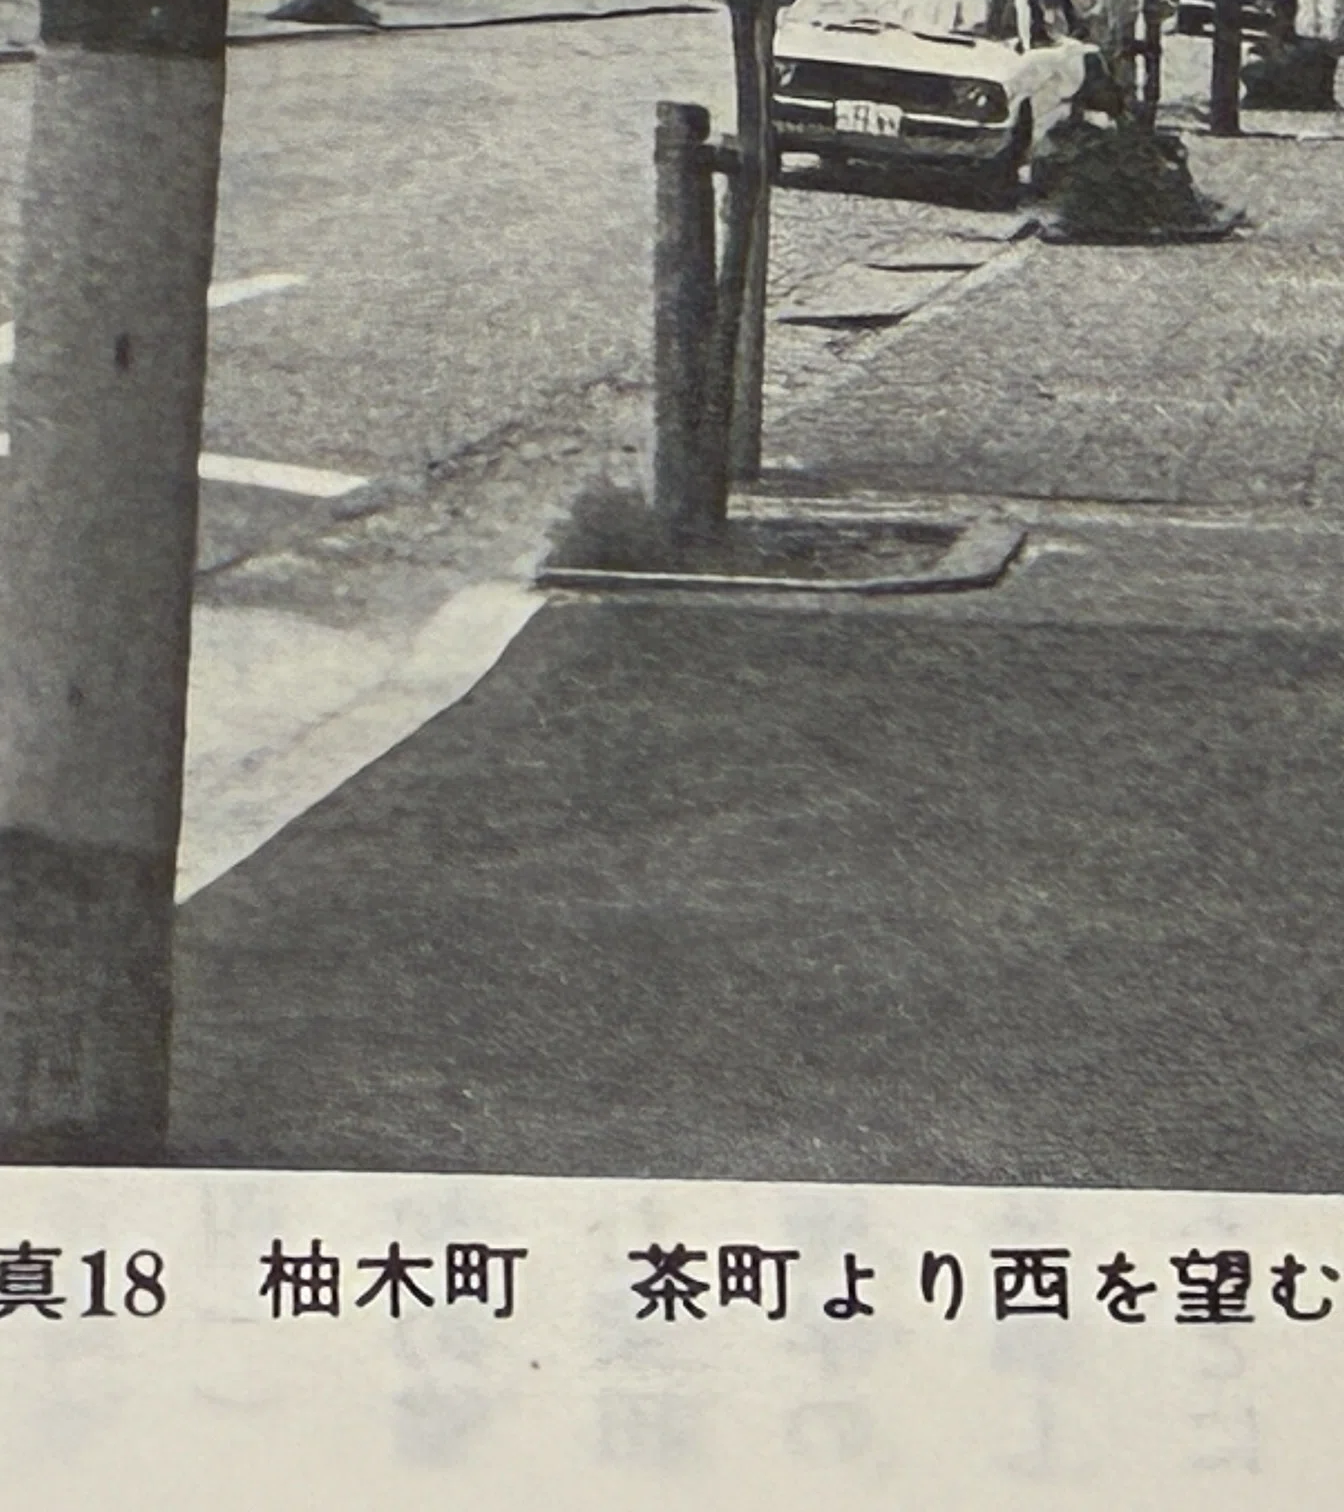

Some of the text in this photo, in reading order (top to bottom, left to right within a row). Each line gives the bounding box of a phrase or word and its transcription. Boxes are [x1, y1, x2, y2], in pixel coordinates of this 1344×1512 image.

[258, 1238, 529, 1320] 柚木町
[627, 1241, 1340, 1325] 茶町より西を望む
